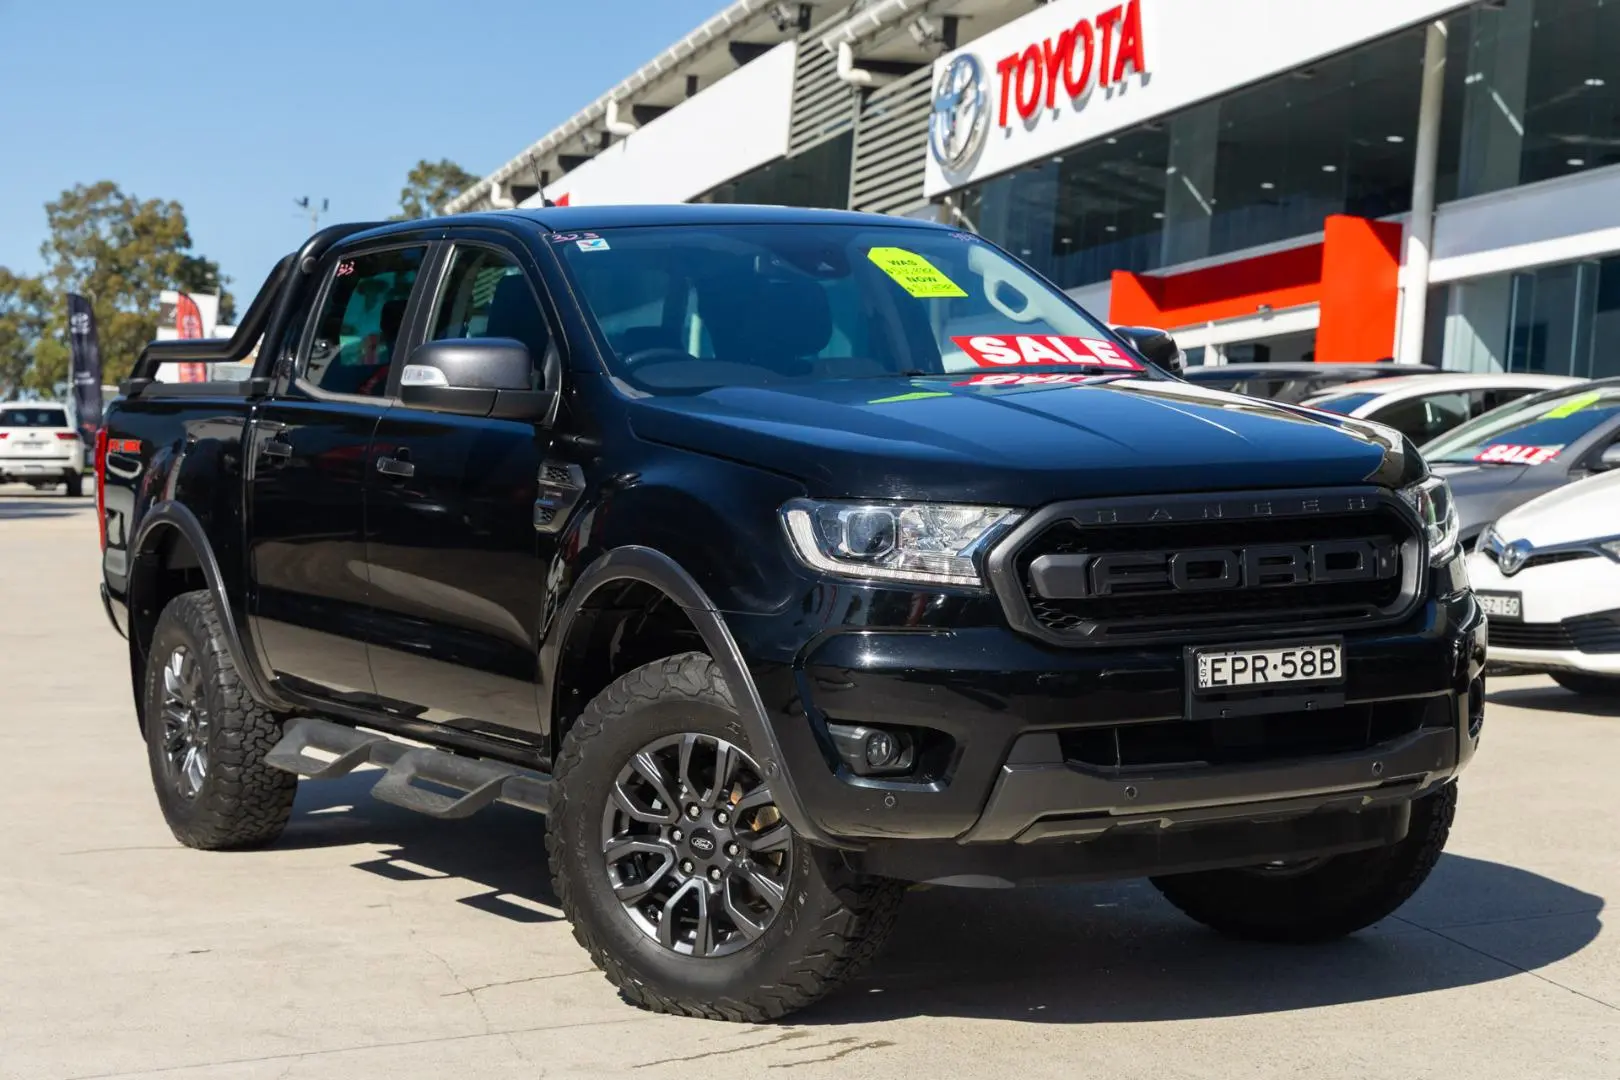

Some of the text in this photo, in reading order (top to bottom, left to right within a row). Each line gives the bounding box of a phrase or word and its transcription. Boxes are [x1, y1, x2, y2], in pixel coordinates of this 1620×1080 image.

[996, 0, 1146, 128] TOYOTA
[969, 335, 1134, 368] SALE
[1481, 444, 1556, 466] SALE
[1097, 496, 1367, 524] RANGER
[1091, 541, 1379, 597] FORD
